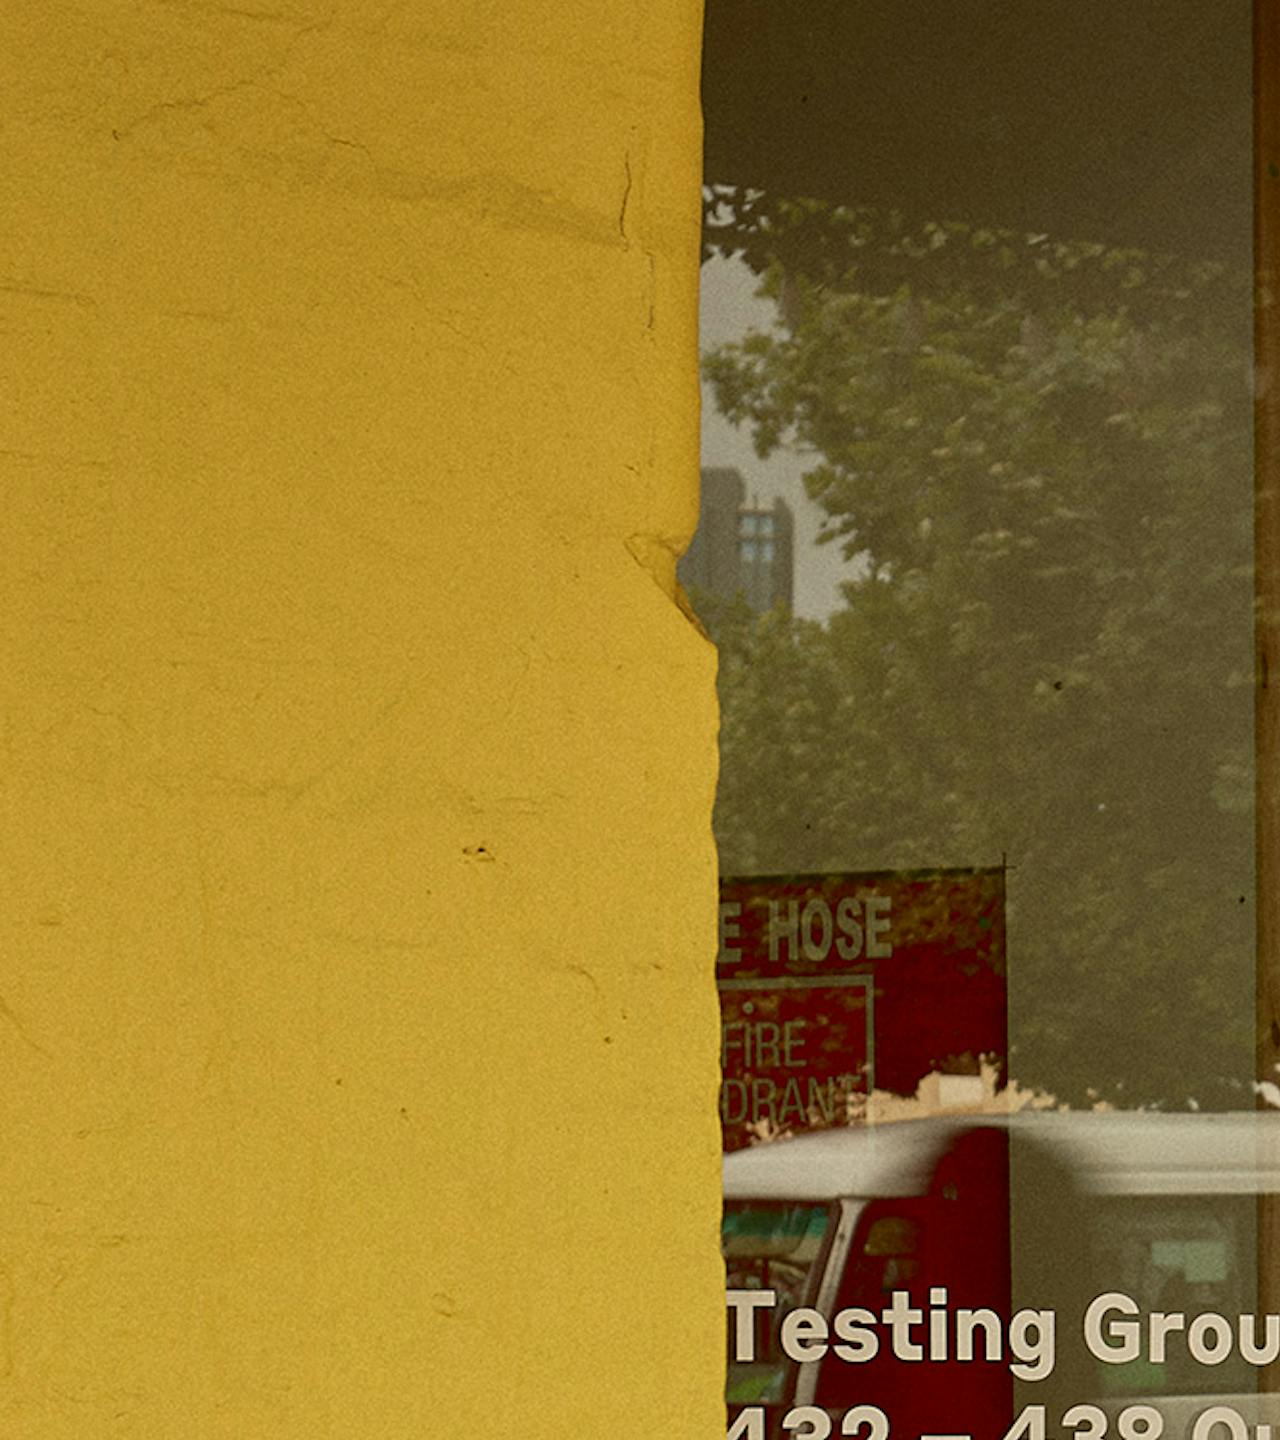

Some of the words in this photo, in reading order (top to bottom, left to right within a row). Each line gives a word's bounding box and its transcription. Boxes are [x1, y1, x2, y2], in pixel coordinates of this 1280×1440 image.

[768, 895, 893, 961] HOSE
[721, 1019, 807, 1068] FIRE
[726, 1286, 1056, 1381] Testing
